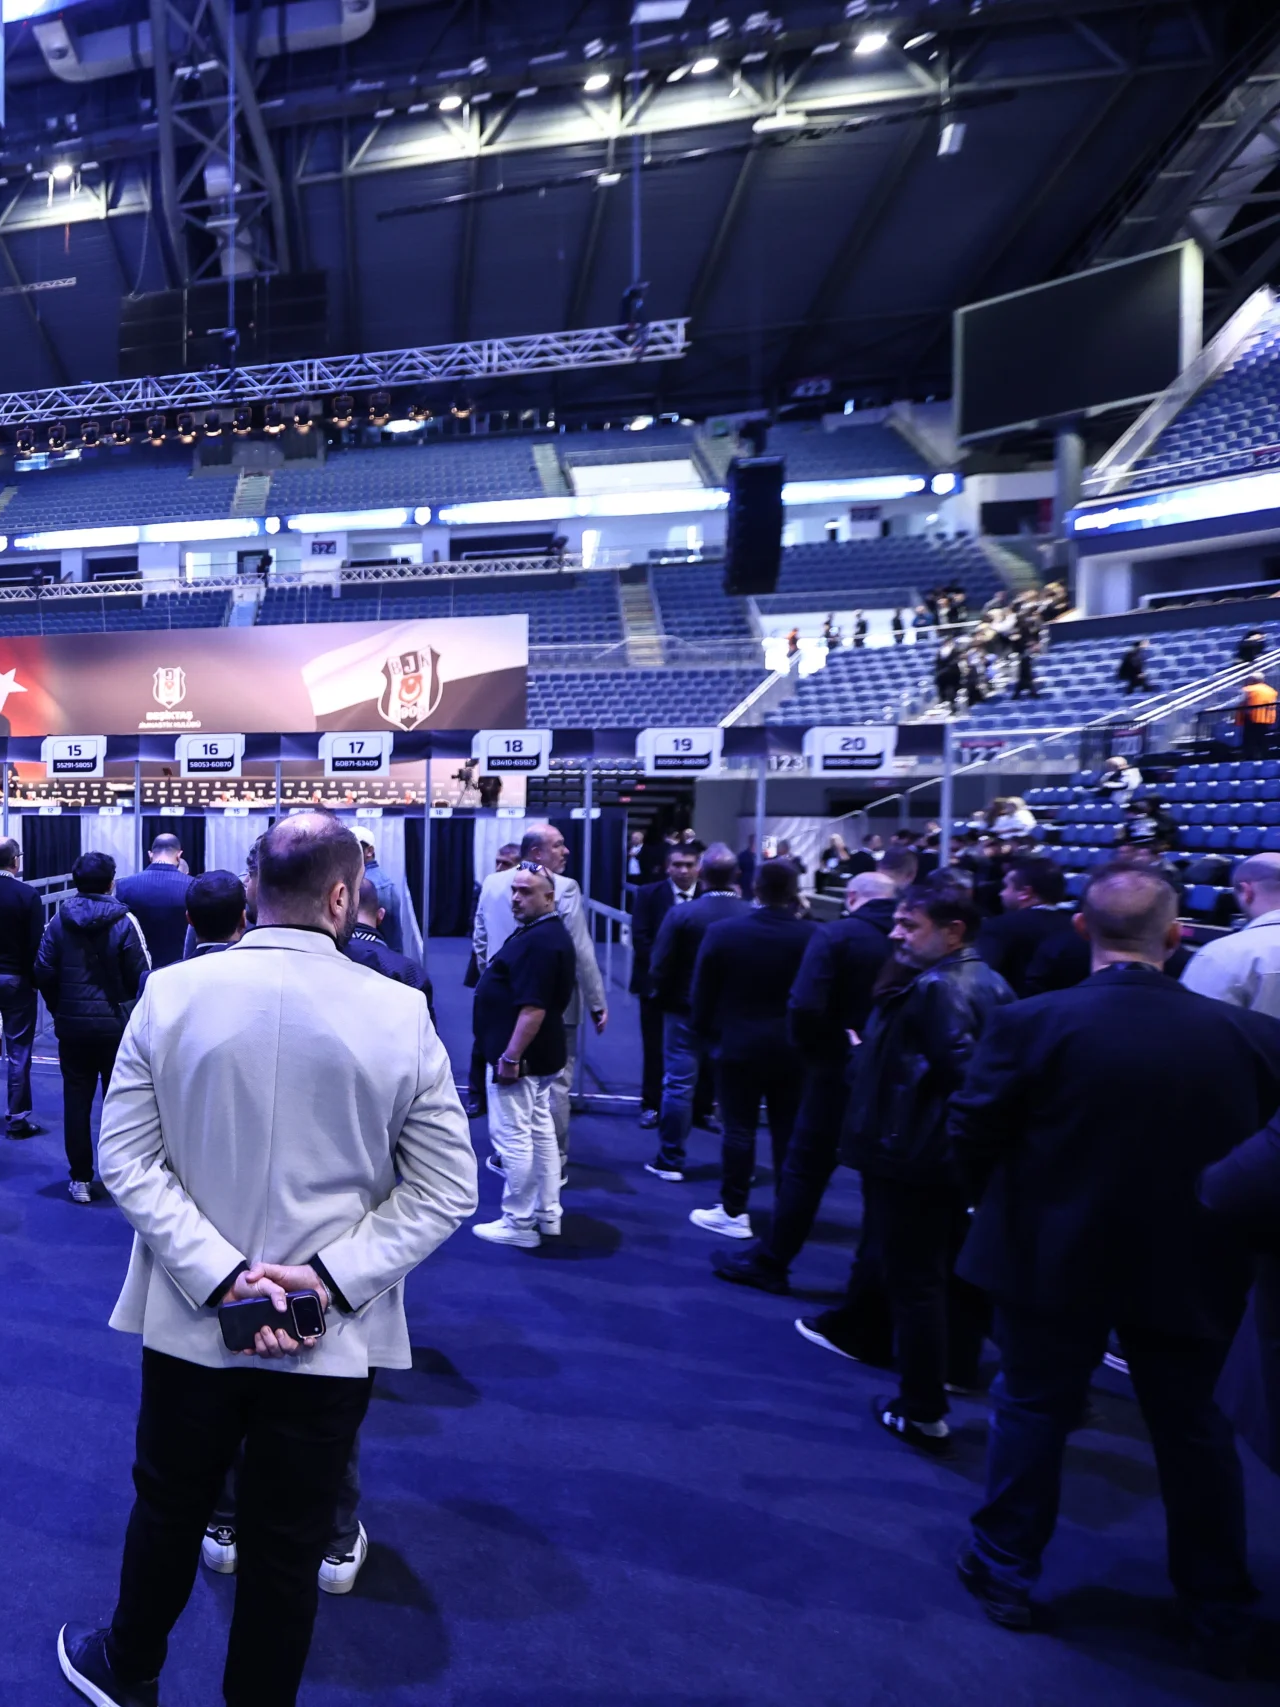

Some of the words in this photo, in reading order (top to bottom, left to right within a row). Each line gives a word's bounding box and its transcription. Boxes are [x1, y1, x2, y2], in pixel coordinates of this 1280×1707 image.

[313, 544, 336, 555] 324
[202, 743, 218, 755] 16
[349, 741, 365, 754] 17
[504, 740, 523, 753] 18
[673, 738, 692, 751] 19
[840, 737, 866, 751] 20
[67, 745, 82, 756] 15
[189, 760, 232, 768] 58053-60870
[334, 759, 379, 768] 60871-63409
[769, 755, 804, 772] 123
